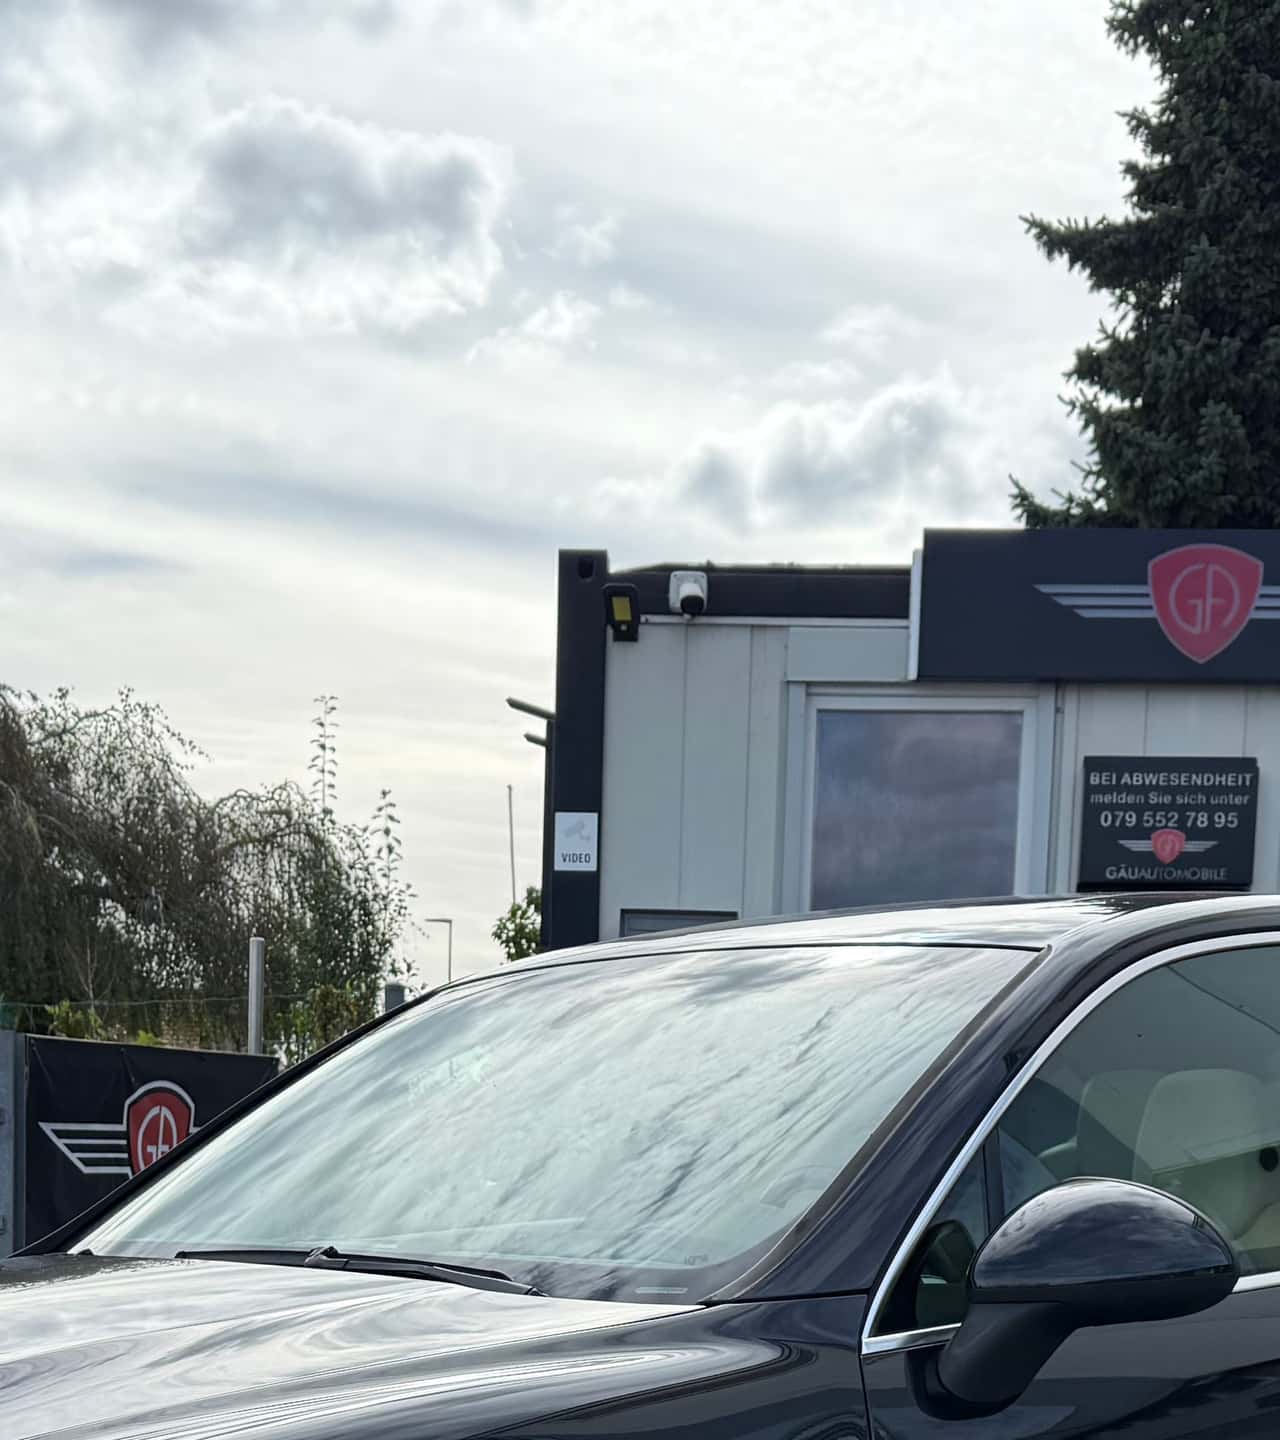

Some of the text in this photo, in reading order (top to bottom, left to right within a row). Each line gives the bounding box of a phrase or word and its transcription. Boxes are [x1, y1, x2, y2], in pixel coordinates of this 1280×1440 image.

[1089, 772, 1254, 787] BEI ABWESENDHEIT
[1090, 792, 1251, 806] melden Sie sich unter
[1100, 811, 1239, 829] 079 552 78 95
[561, 852, 591, 864] VIDEO
[1105, 864, 1228, 881] GÄUAUTOMOBILE
